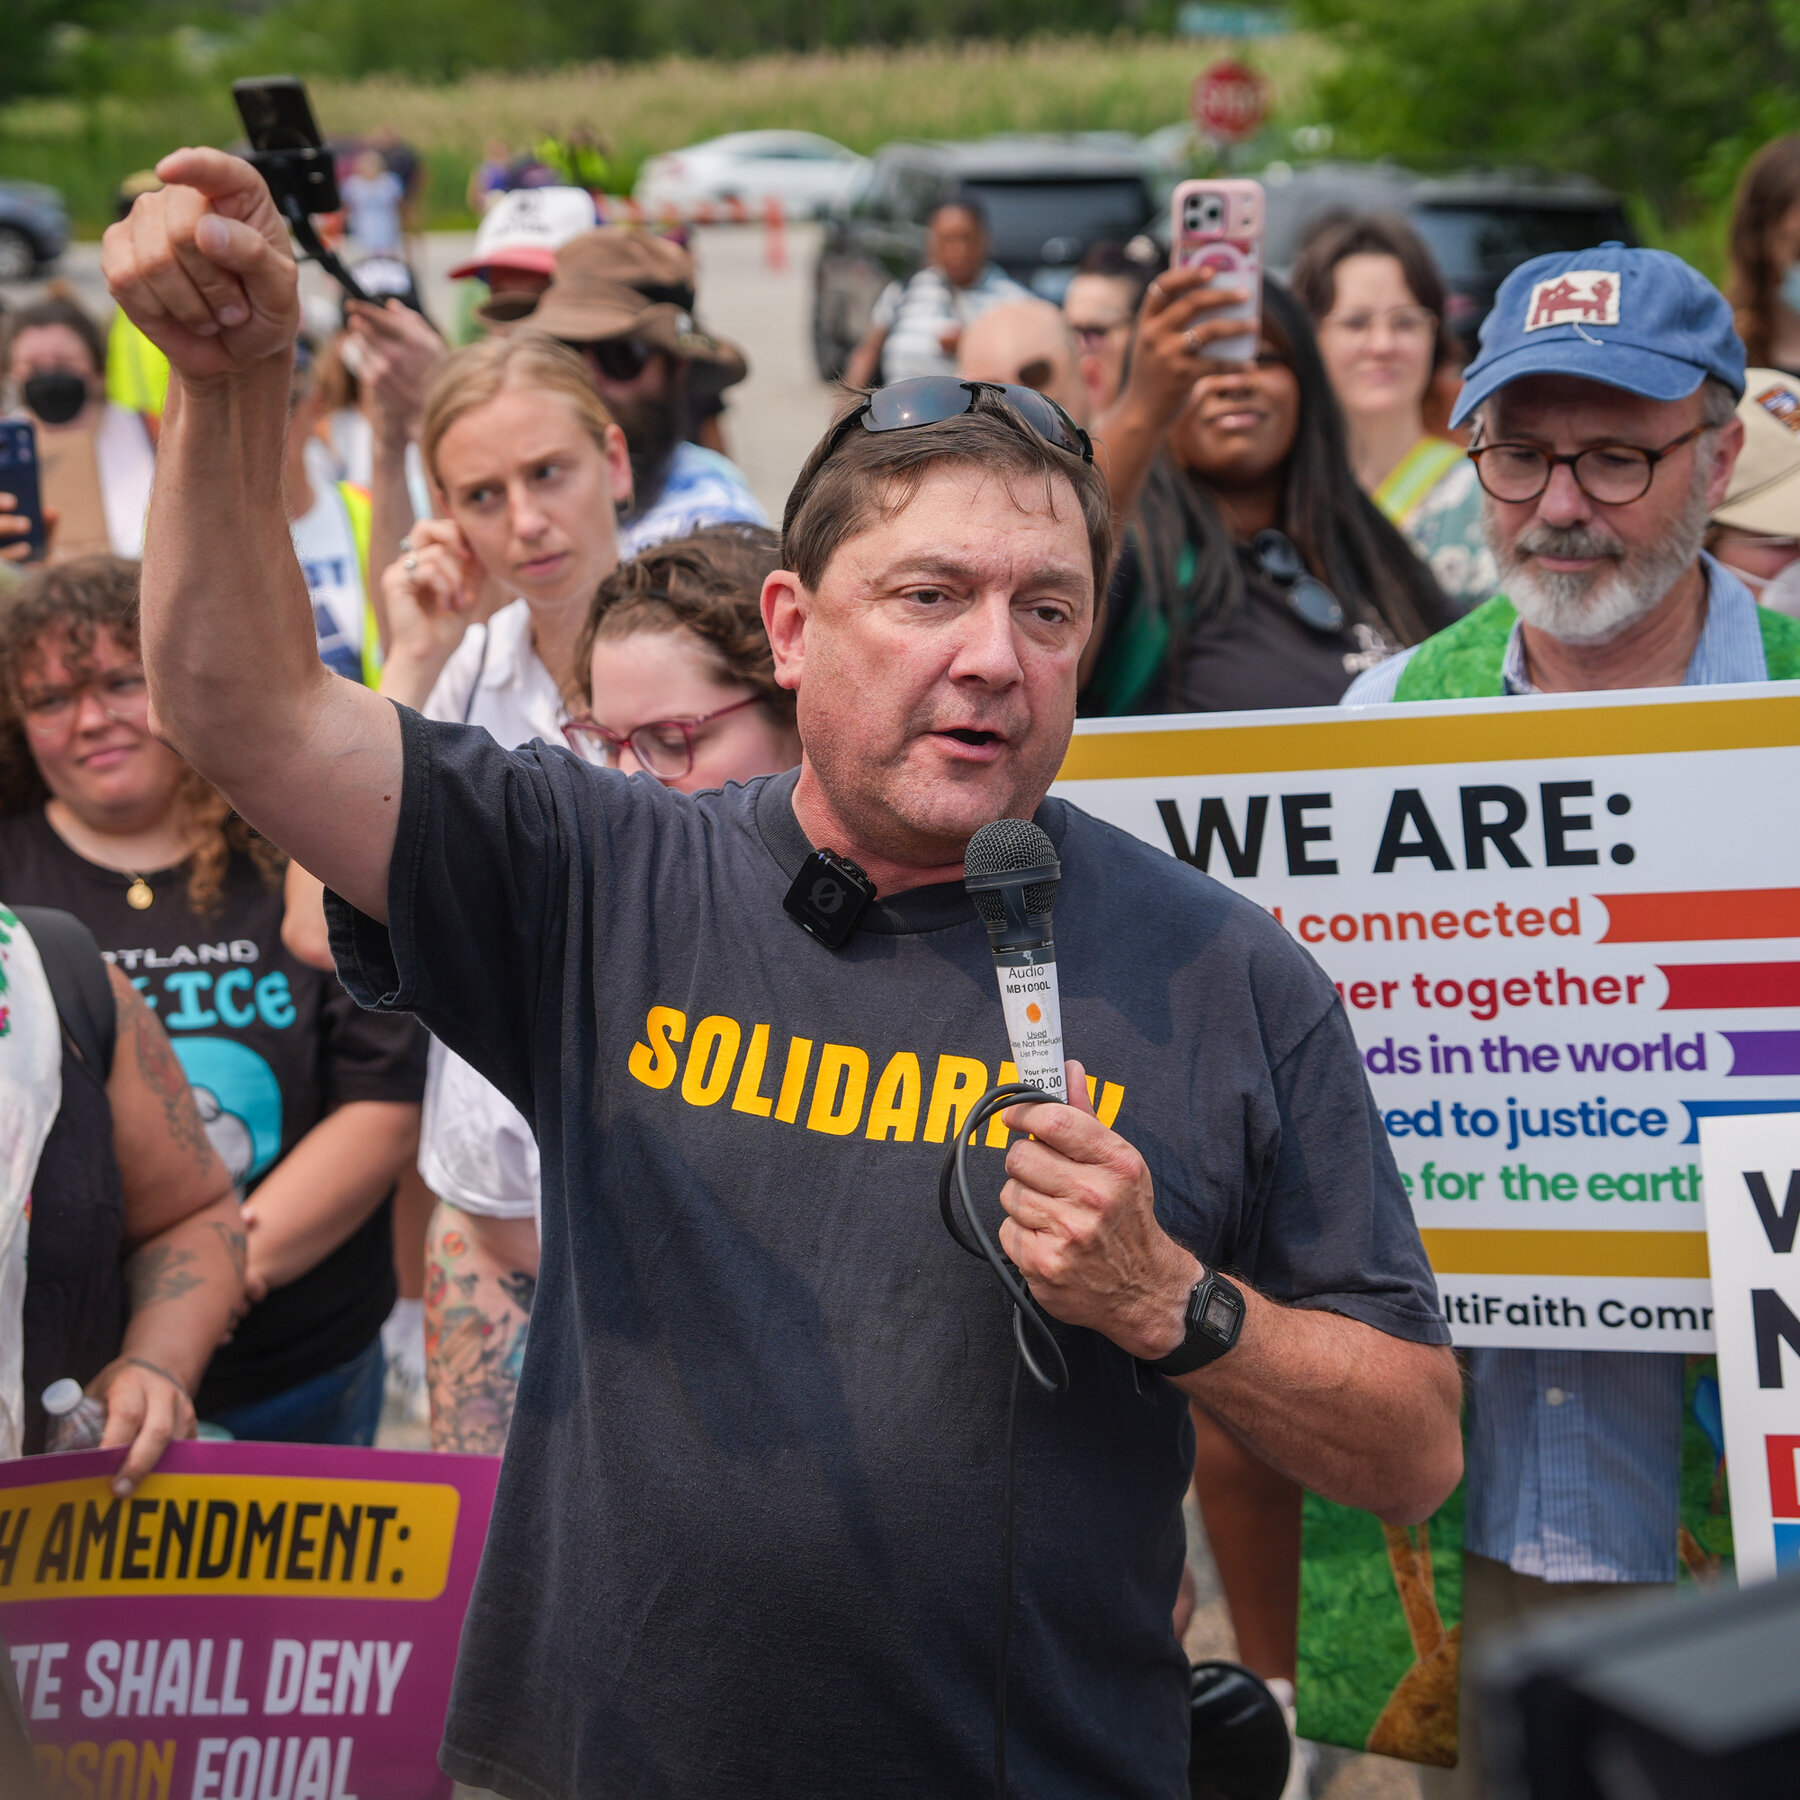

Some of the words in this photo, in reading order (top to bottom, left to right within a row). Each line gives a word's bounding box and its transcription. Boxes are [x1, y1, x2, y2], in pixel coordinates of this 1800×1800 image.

[1156, 792, 1338, 878] WE
[1373, 780, 1636, 874] ARE:
[1299, 897, 1581, 943] connected
[1006, 981, 1051, 994] MB1000L
[1009, 966, 1044, 979] Audio
[164, 967, 296, 1029] ICE
[1335, 979, 1399, 1010] er
[1412, 967, 1645, 1021] together
[1020, 1050, 1031, 1058] List
[1032, 1049, 1049, 1057] Price
[1022, 1040, 1035, 1048] Not
[1027, 1030, 1047, 1040] Used
[1361, 1037, 1421, 1075] ds
[1429, 1034, 1473, 1074] in
[1480, 1036, 1560, 1074] the
[1567, 1033, 1707, 1073] world
[627, 1005, 1125, 1149] SOLIDARIY
[1041, 1067, 1058, 1075] Price
[1380, 1100, 1443, 1138] ed
[1451, 1102, 1499, 1138] to
[1506, 1096, 1669, 1150] justice
[1420, 1161, 1484, 1200] for
[1499, 1163, 1578, 1201] the
[1444, 1293, 1587, 1328] ltiFaith
[0, 1507, 30, 1587] H
[34, 1499, 411, 1585] AMENDMENT:
[9, 1642, 69, 1720] TE
[80, 1638, 249, 1719] SHALL
[262, 1639, 413, 1716] DENY
